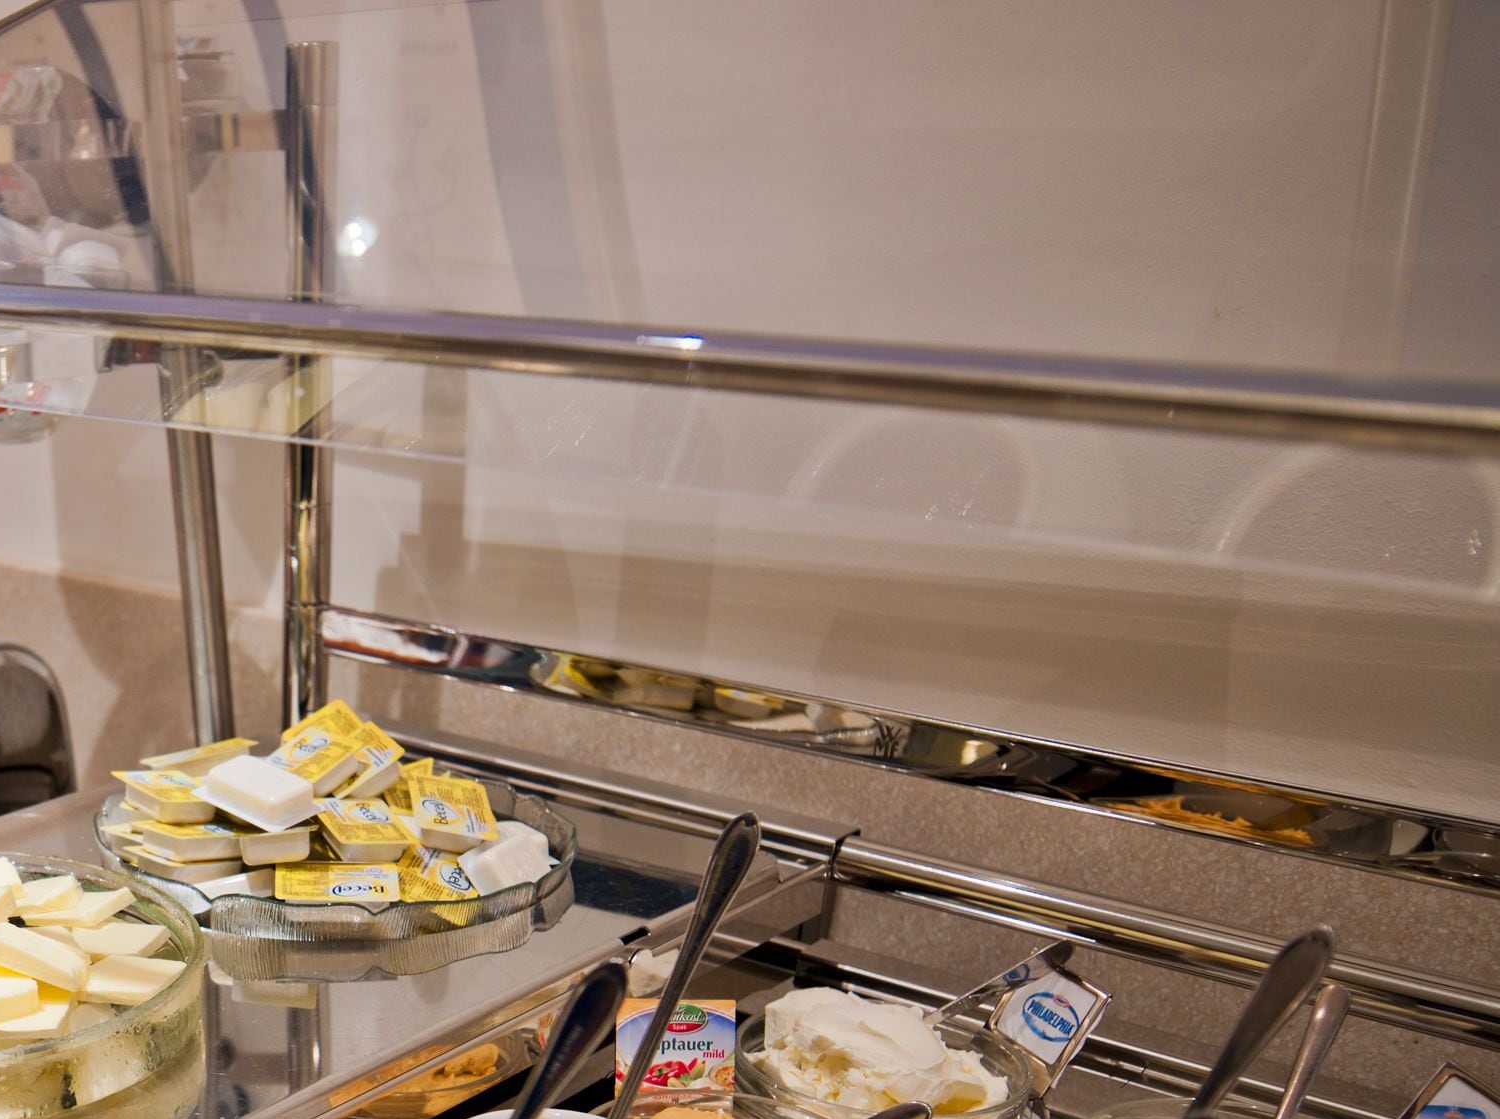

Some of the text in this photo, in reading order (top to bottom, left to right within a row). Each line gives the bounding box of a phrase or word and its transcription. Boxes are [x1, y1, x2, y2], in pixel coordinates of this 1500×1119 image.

[430, 801, 449, 825] Becel
[338, 885, 385, 894] Becel
[1027, 999, 1075, 1036] PHILADELPHIA
[672, 1023, 687, 1031] Spak
[661, 1038, 714, 1055] ptauer
[703, 1049, 725, 1059] mild
